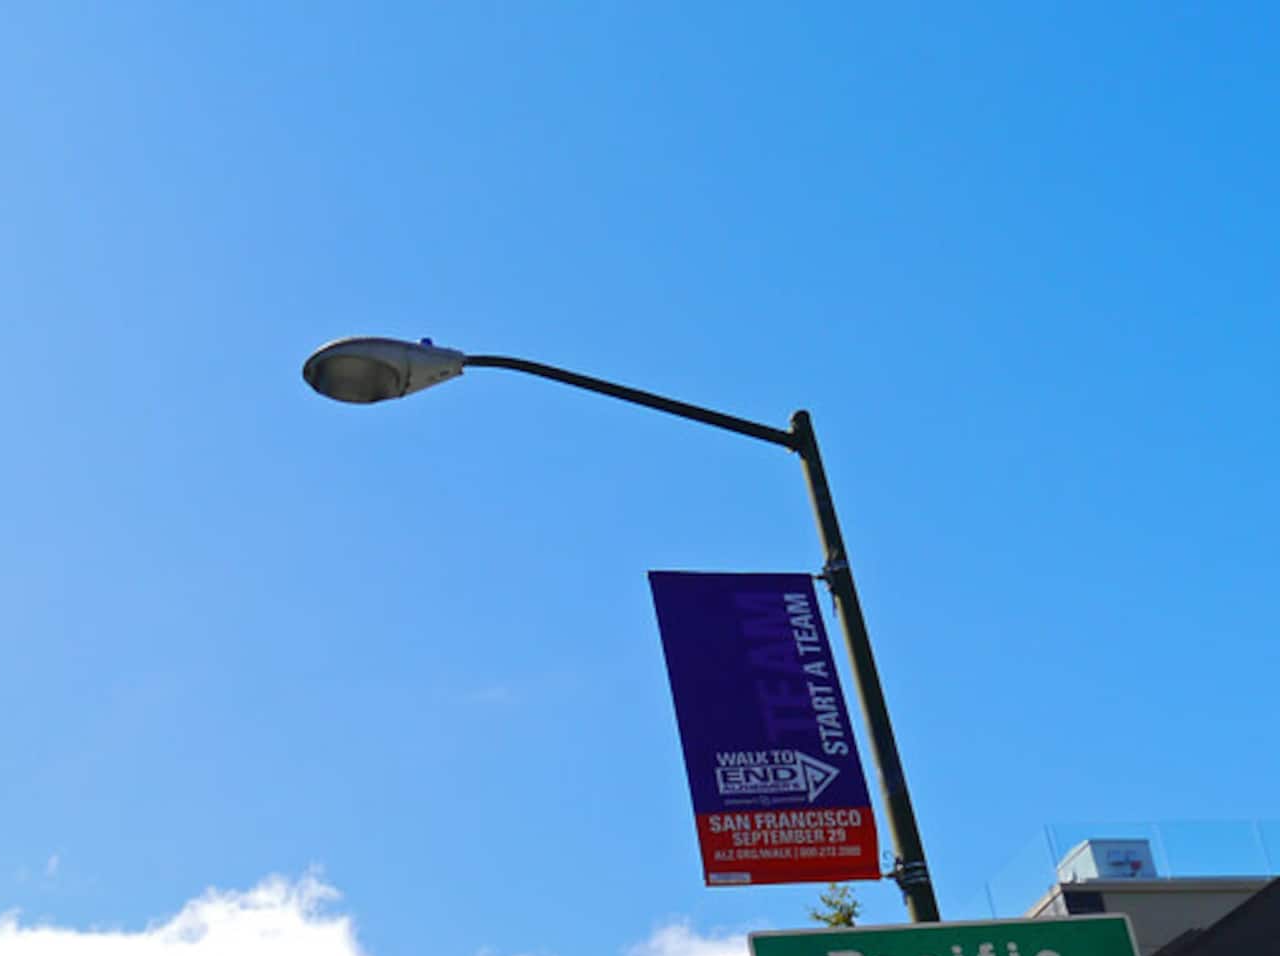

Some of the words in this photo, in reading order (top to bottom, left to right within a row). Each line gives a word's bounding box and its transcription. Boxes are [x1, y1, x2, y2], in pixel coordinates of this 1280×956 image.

[784, 593, 822, 656] TEAM
[803, 661, 829, 679] A
[807, 682, 848, 756] START
[716, 751, 769, 767] WALK
[772, 750, 794, 764] TO
[721, 766, 799, 784] END
[709, 814, 751, 833] SAN
[754, 809, 862, 830] FRANCISCO
[732, 829, 825, 847] SEPTEMBER
